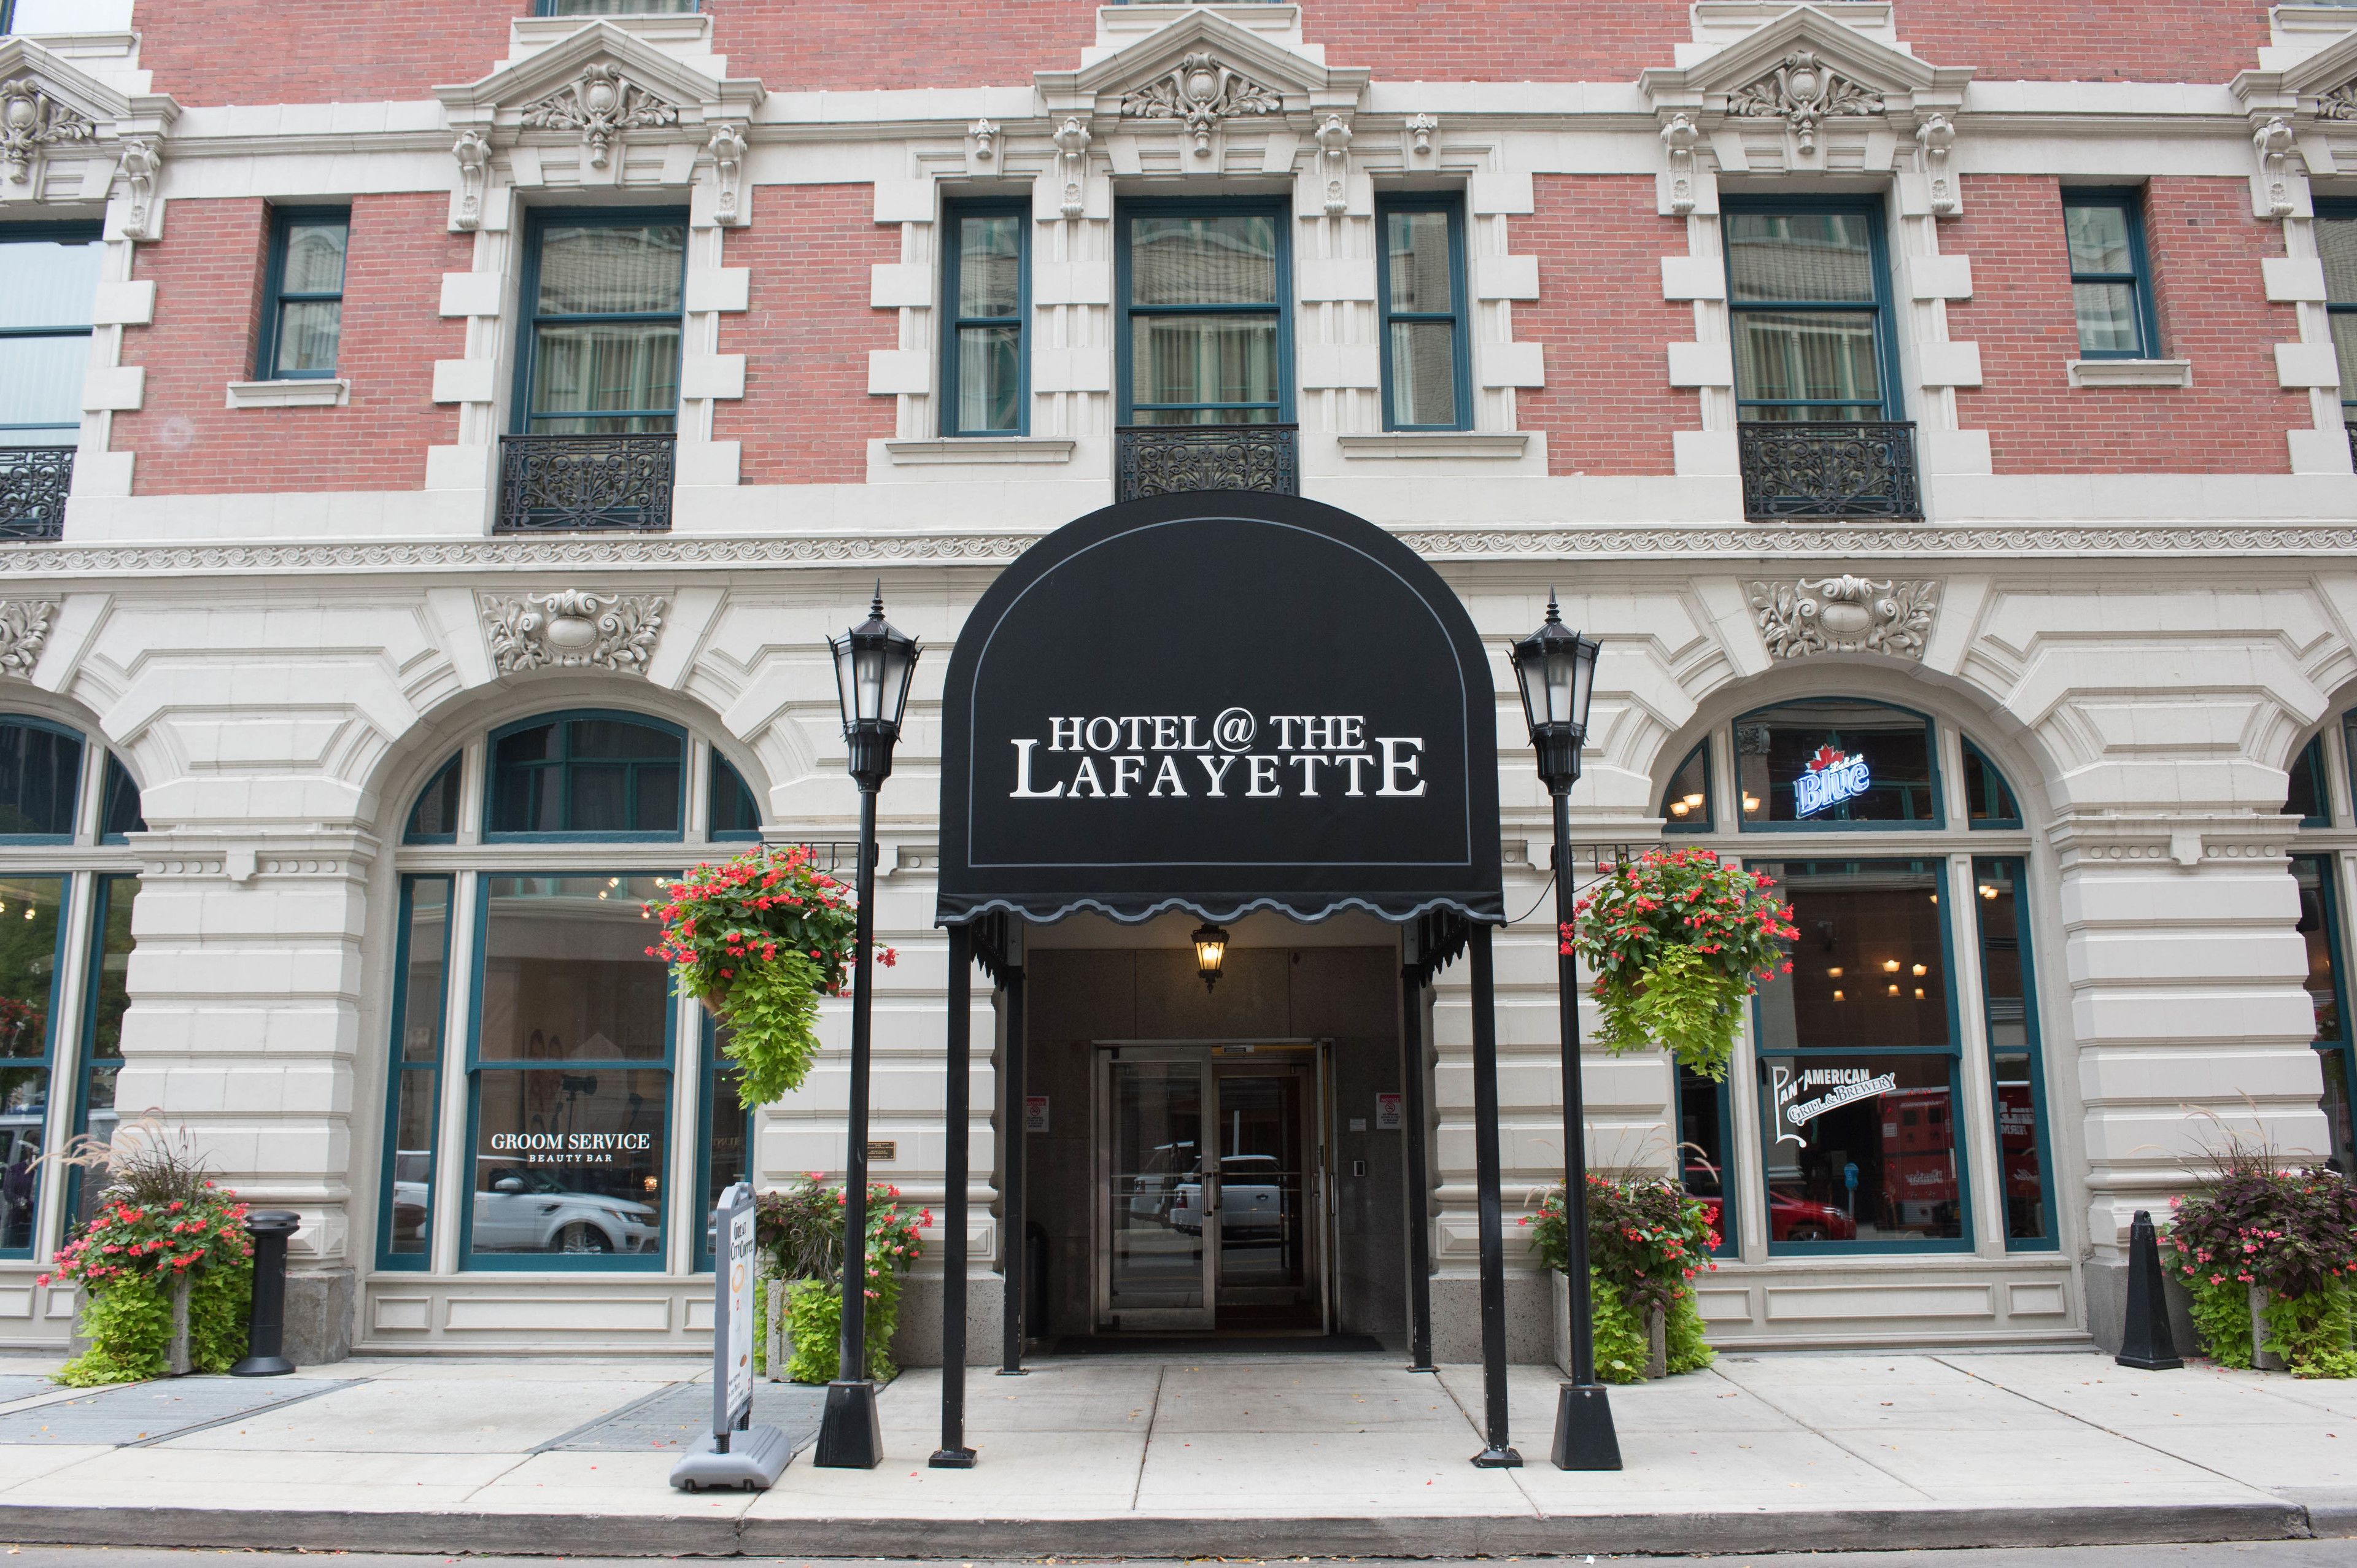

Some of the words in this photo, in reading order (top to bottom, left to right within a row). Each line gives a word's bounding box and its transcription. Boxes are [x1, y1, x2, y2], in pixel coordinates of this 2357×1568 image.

[1269, 715, 1366, 751] THE
[1010, 737, 1427, 798] LAFAYETTE
[1796, 763, 1870, 816] Blue
[1787, 1097, 1826, 1122] GRILL
[1826, 1093, 1836, 1105] &
[1835, 1072, 1895, 1102] BREWERY
[491, 1134, 563, 1149] GROOM
[568, 1134, 650, 1149] SERVICE
